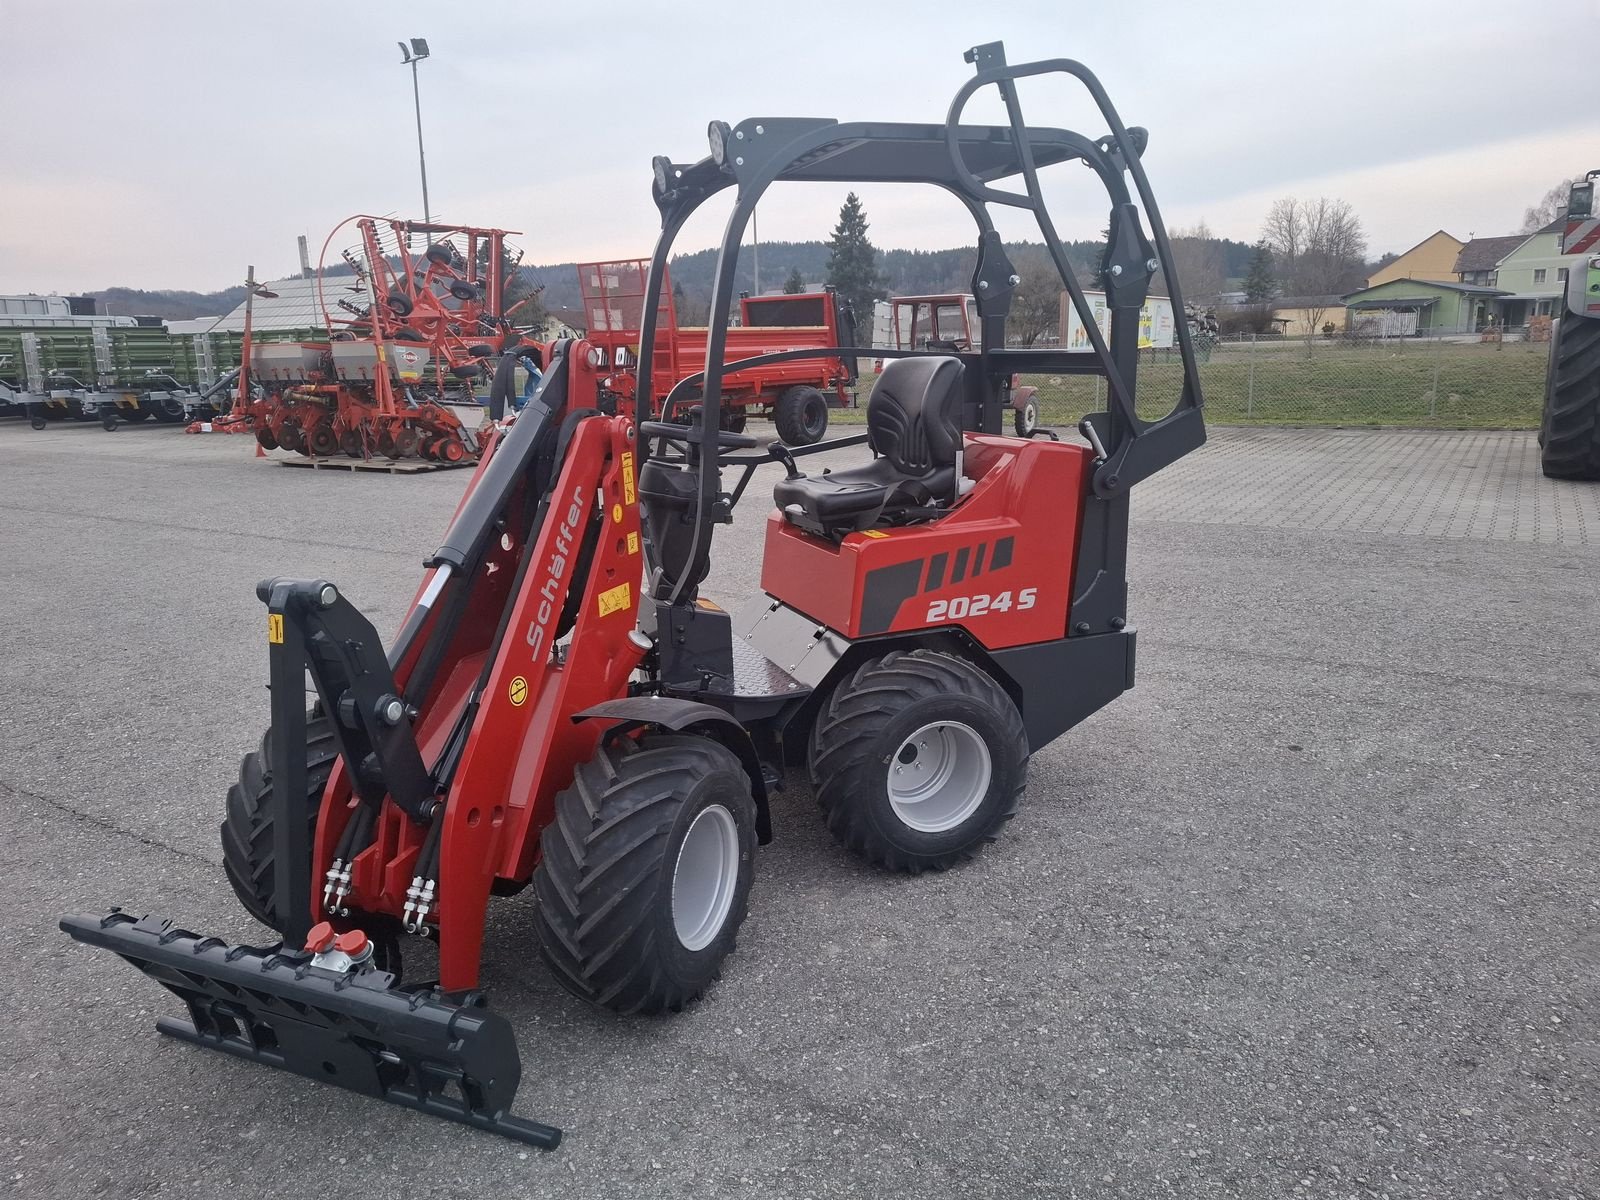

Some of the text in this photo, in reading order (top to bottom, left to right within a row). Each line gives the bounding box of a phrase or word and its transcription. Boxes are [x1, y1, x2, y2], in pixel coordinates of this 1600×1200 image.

[526, 485, 582, 662] Schäffer
[926, 587, 1038, 623] 2024 S
